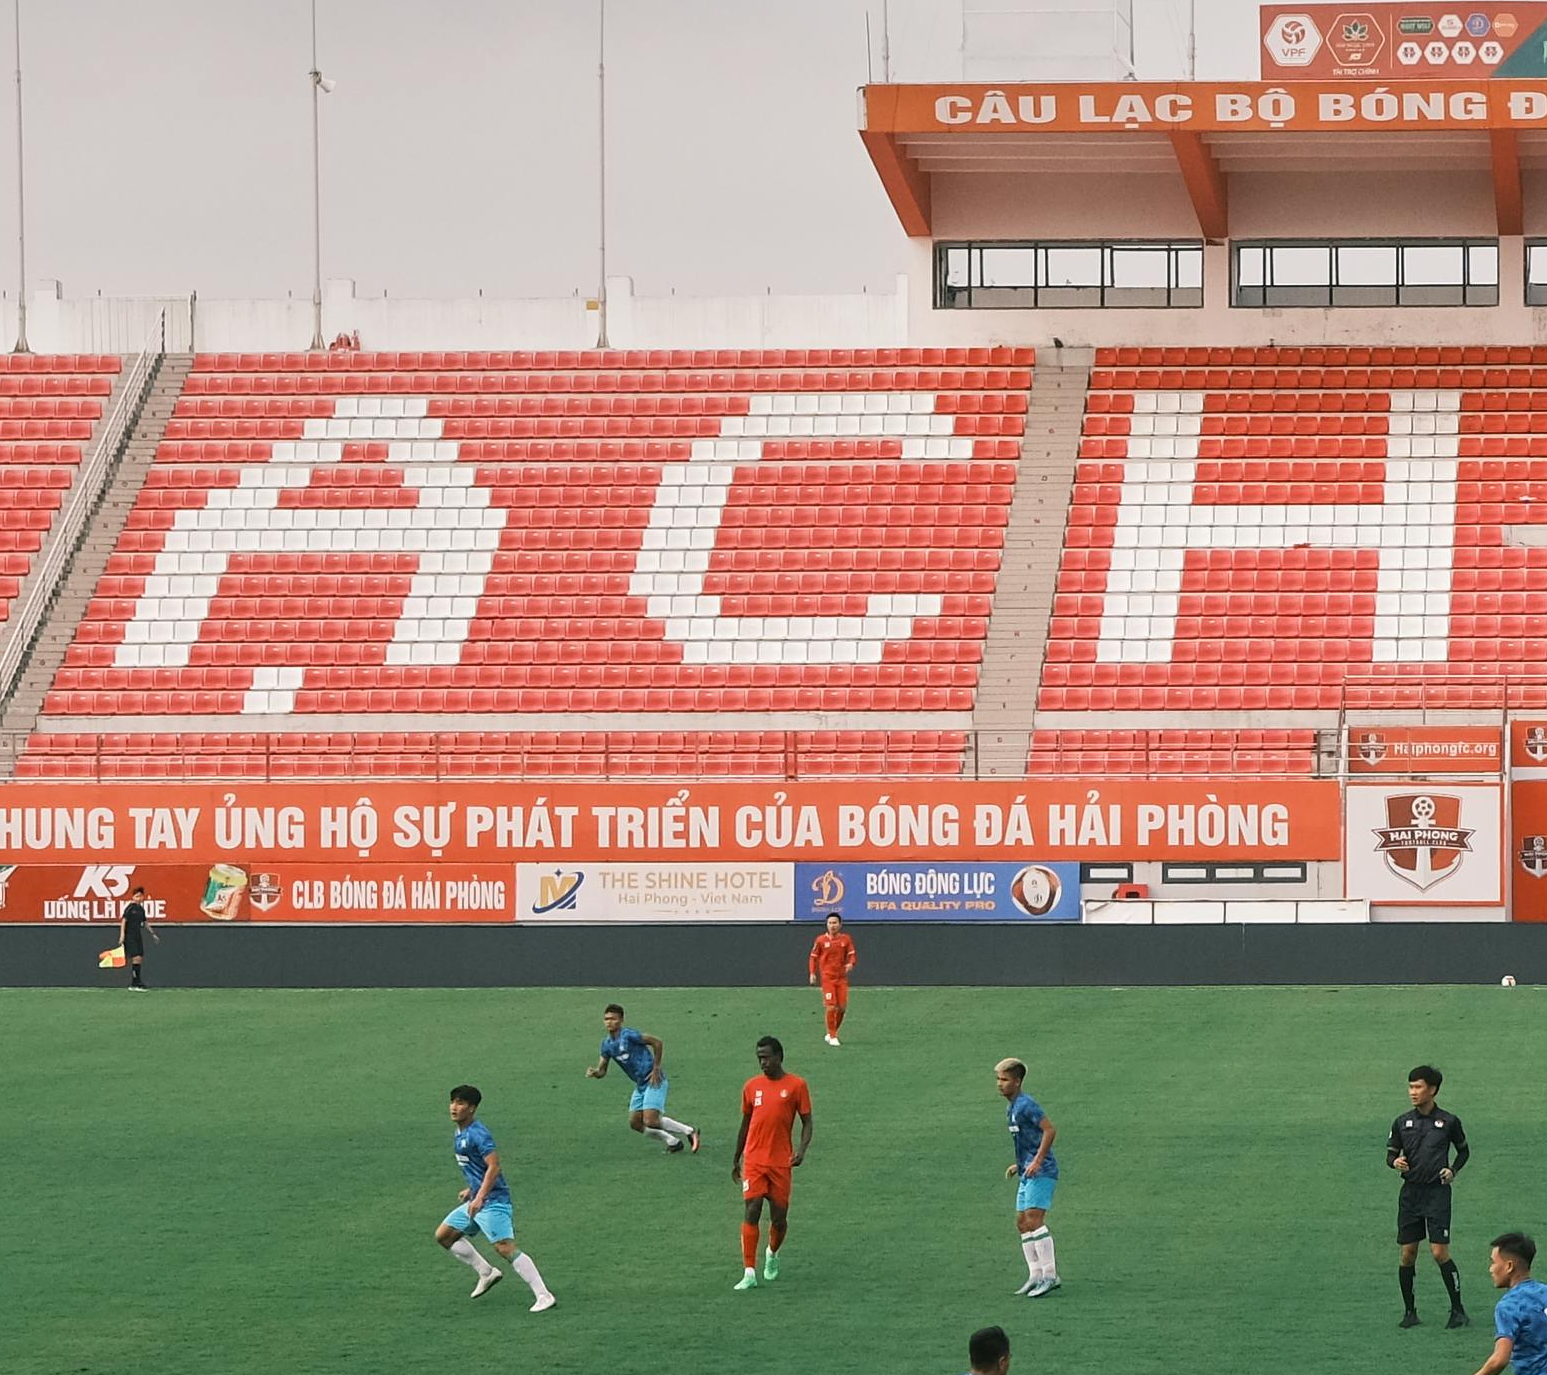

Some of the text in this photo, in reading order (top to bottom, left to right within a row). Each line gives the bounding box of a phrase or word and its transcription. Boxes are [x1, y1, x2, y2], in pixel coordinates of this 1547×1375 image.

[1282, 48, 1306, 57] VPF
[935, 92, 1056, 125] CÂU
[1079, 94, 1193, 128] LẠC
[1215, 91, 1296, 128] BỘ
[1319, 89, 1487, 122] BÓNG
[129, 808, 200, 849] TAY
[215, 793, 304, 849] ỦNG
[321, 798, 378, 857] HỘ
[394, 801, 457, 856] SỰ
[467, 797, 578, 847] PHÁT
[592, 790, 719, 848] TRIỂN
[736, 792, 823, 847] CỦA
[839, 796, 959, 846] BÓNG
[974, 796, 1034, 845] ĐÁ
[1049, 790, 1120, 845] HẢI
[1138, 794, 1288, 846] PHÒNG
[1390, 831, 1458, 841] HAI PHONG
[73, 865, 137, 898] K5
[293, 872, 505, 909] CLB BÓNG ĐÁ HẢI PHÒNG
[599, 871, 783, 890] THE SHINE HOTEL
[867, 869, 995, 898] BÓNG ĐỘNG LỰC
[44, 894, 117, 922] UỐNG LÀ
[613, 890, 764, 907] Hai
[868, 900, 995, 910] FIFA QUALITY PRO
